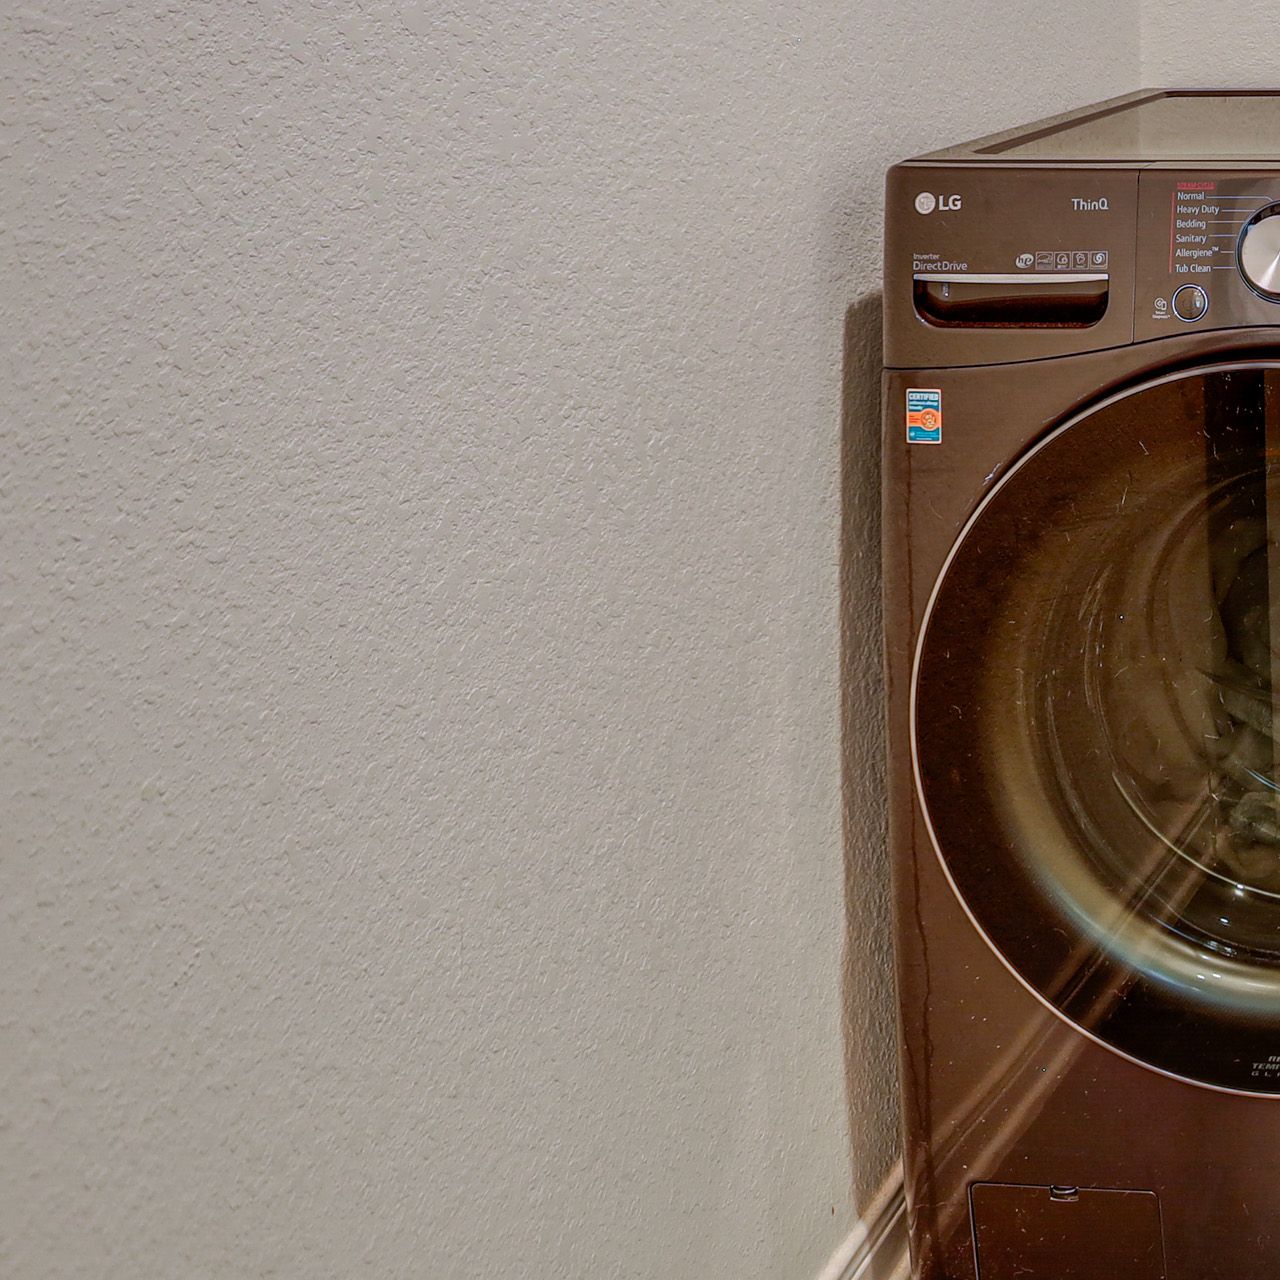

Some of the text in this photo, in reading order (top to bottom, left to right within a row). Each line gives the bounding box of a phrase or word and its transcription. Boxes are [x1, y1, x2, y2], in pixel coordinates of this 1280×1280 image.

[1177, 192, 1205, 200] Normal
[939, 195, 962, 211] LG
[1071, 198, 1109, 211] ThinQ
[1177, 205, 1220, 215] Heavy Duty
[1176, 220, 1206, 230] Bedding
[1176, 234, 1207, 244] Sanitary
[1176, 264, 1211, 273] Tub Clean
